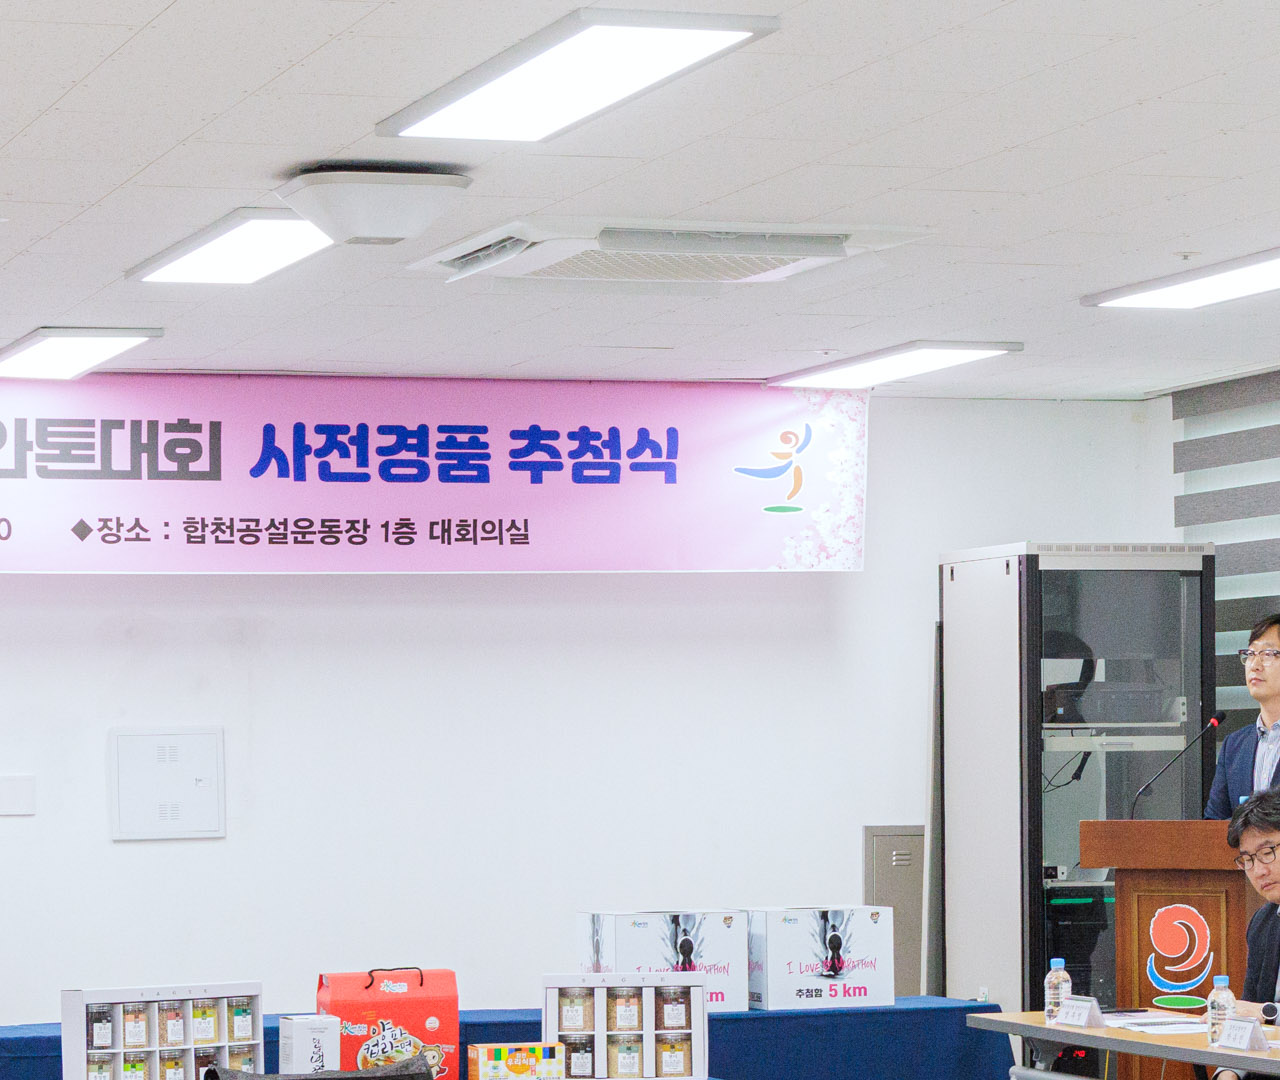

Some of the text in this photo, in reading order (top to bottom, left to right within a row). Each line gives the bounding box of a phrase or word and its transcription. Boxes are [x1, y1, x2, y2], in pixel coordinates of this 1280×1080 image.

[248, 422, 492, 485] 사전경품
[508, 424, 679, 485] 추첨식
[182, 517, 370, 546] 합천공설운동장
[379, 518, 418, 545] 1층
[428, 517, 531, 546] 대회의실
[799, 961, 821, 973] LOVE
[795, 983, 868, 999] 추첨함 5 km
[370, 1020, 407, 1041] 양파
[363, 1039, 413, 1059] 컵라면
